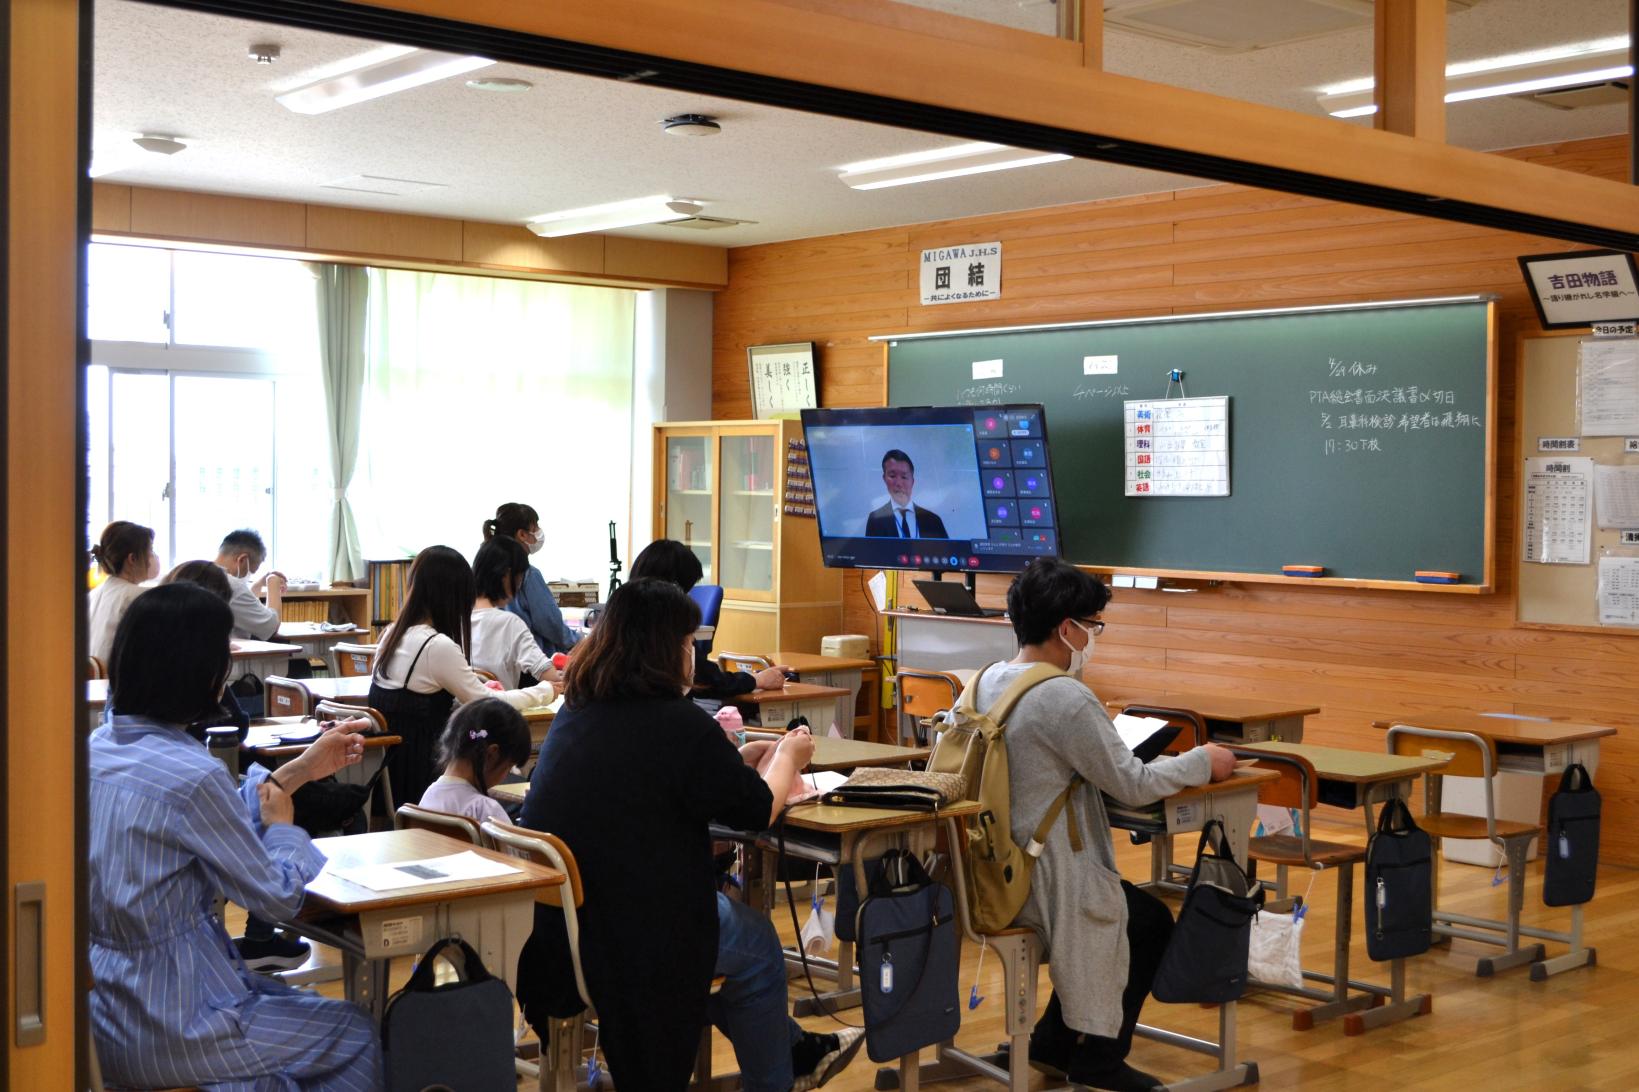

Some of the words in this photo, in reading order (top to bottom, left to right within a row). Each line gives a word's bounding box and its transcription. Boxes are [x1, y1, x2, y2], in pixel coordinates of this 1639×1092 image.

[924, 248, 966, 262] MIGAWA
[935, 262, 984, 290] 団結
[1547, 270, 1618, 290] 吉田物語
[1595, 325, 1633, 334] 今日の予定
[1137, 424, 1151, 434] 体育
[1136, 439, 1150, 449] 理科
[1542, 439, 1575, 449] 時間割表
[1137, 454, 1151, 464] 国語
[1545, 464, 1571, 473] 時間割
[1137, 470, 1151, 479] 社会
